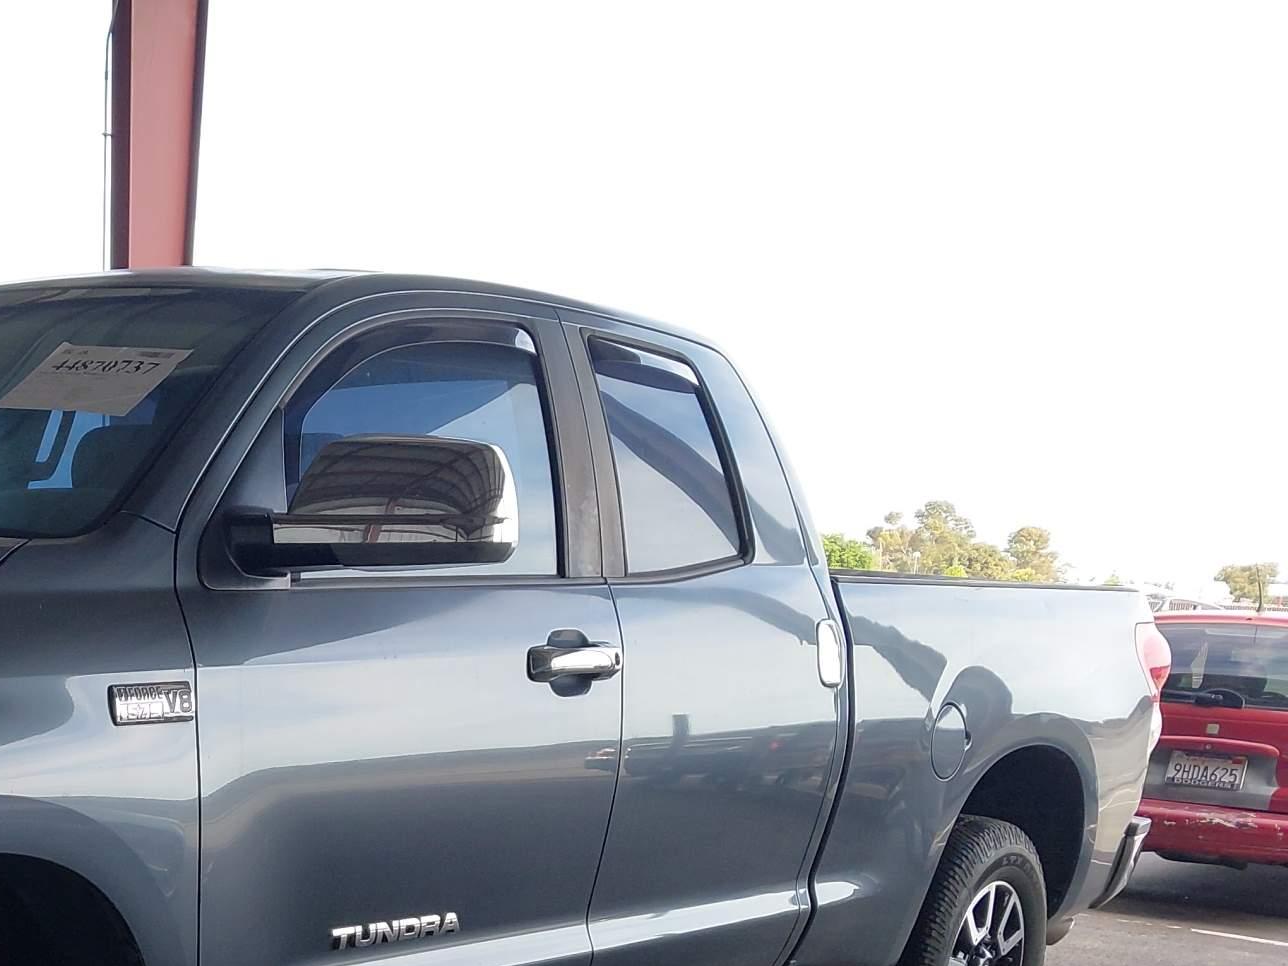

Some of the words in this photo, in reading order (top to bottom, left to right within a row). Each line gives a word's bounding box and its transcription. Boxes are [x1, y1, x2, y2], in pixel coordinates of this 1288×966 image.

[52, 359, 161, 376] 44870737
[162, 688, 193, 713] V8
[1173, 763, 1239, 783] 9HDA625
[331, 912, 461, 950] TUNDRA
